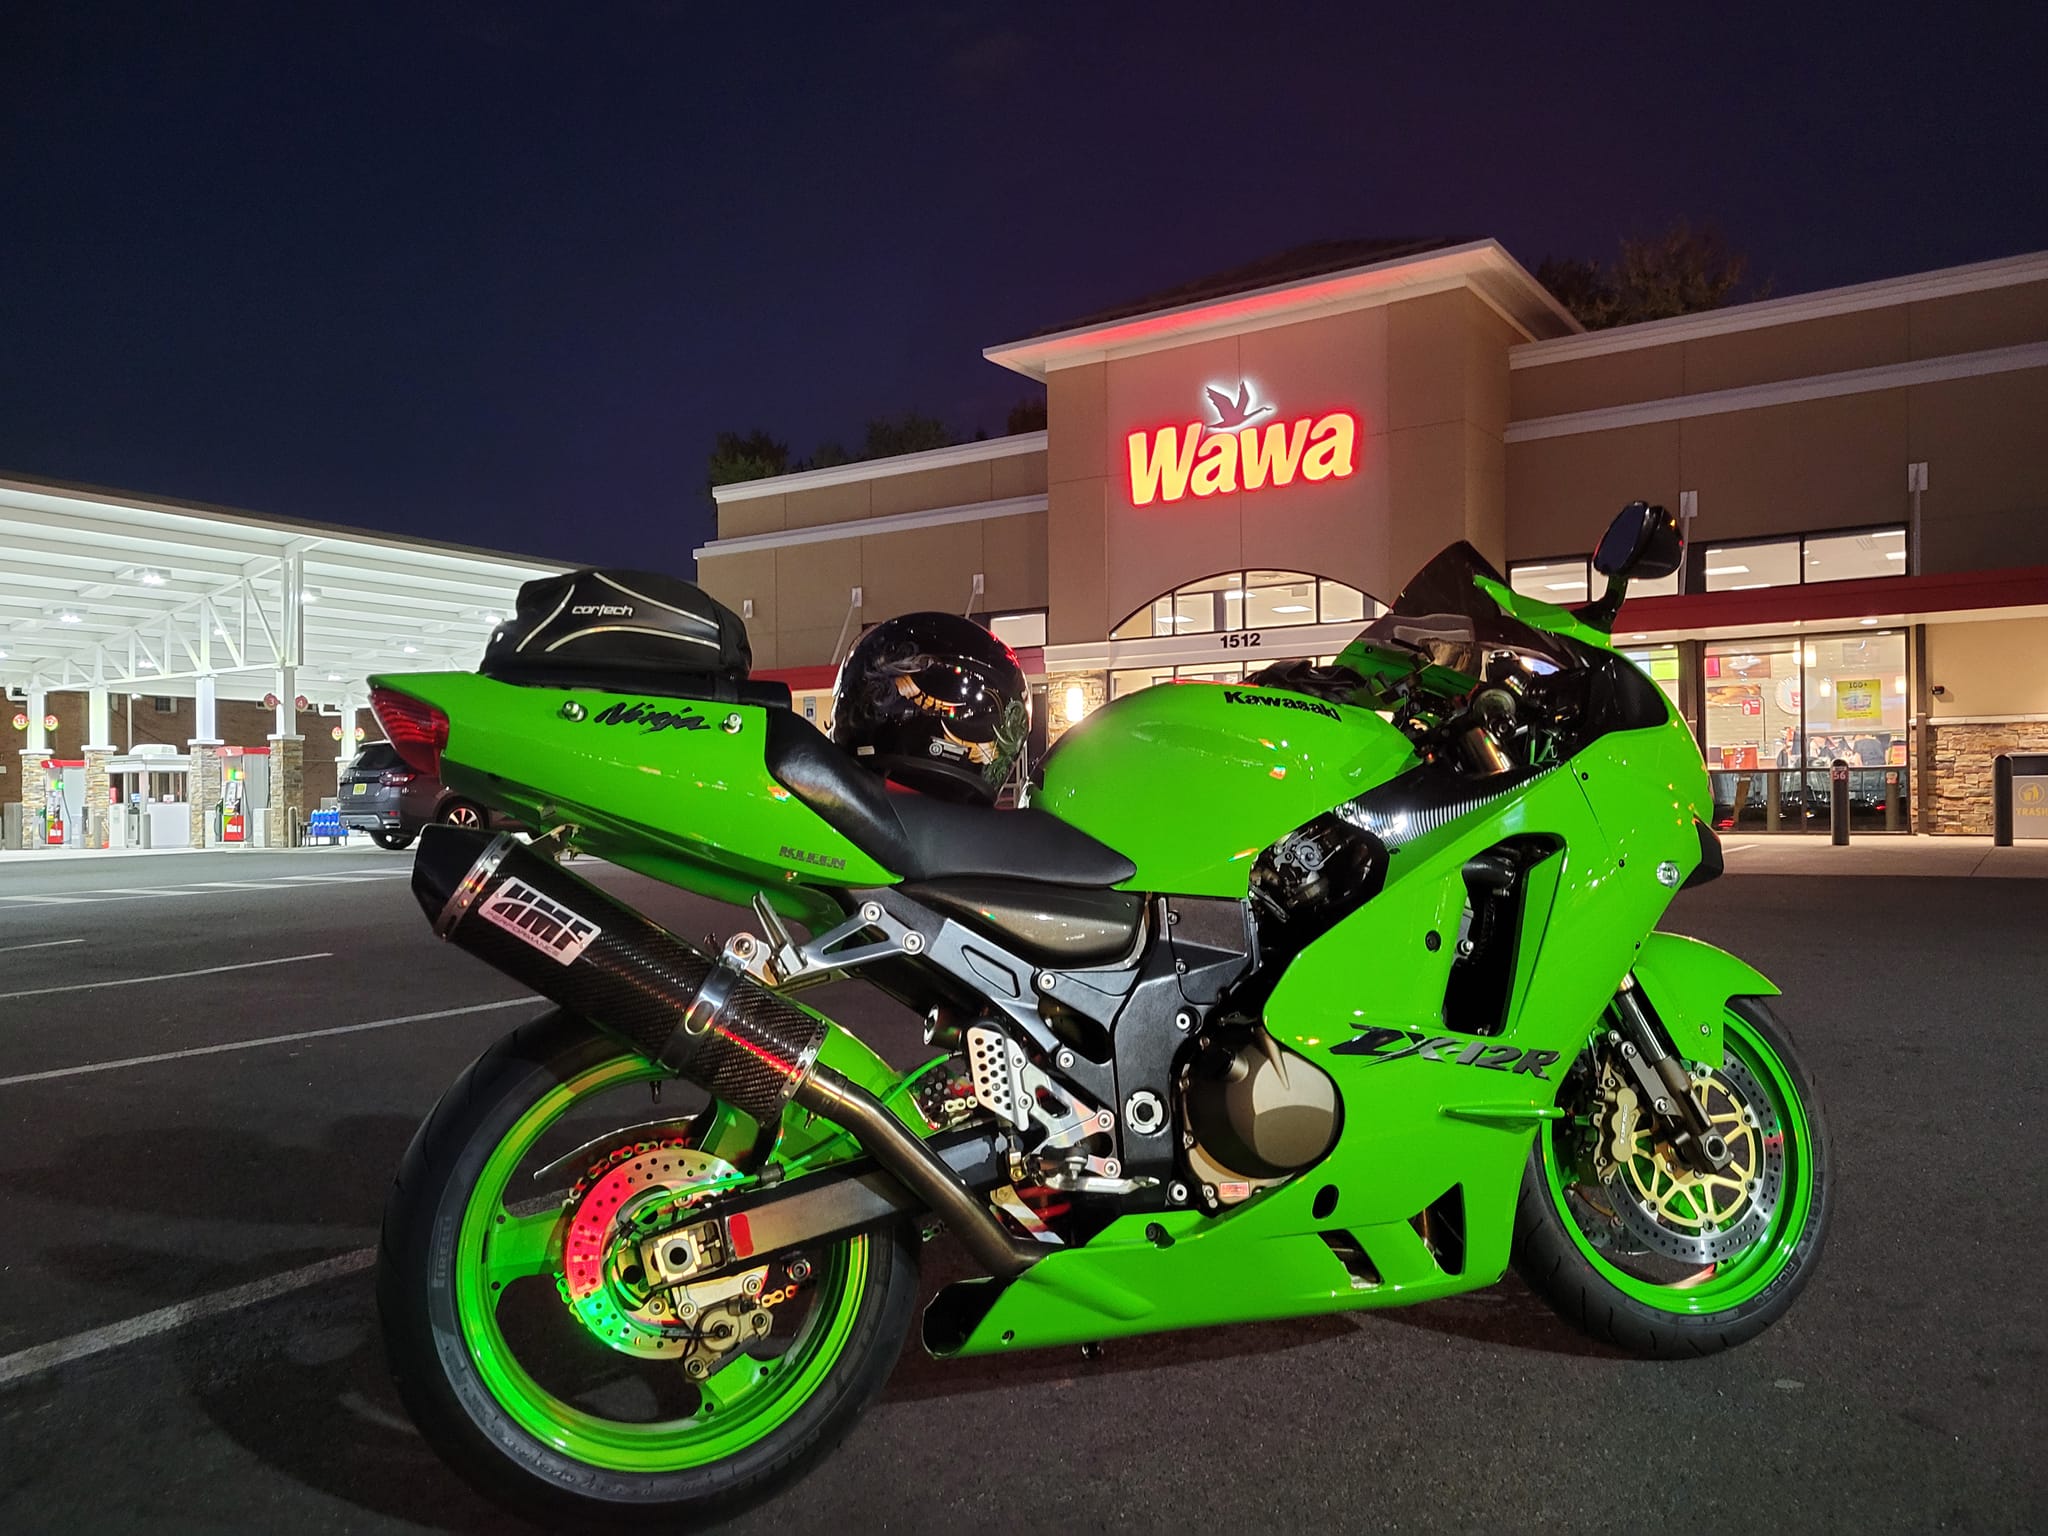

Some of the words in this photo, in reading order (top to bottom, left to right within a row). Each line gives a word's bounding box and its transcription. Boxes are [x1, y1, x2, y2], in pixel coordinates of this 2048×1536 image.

[1128, 412, 1355, 506] Wawa
[571, 603, 634, 618] cortech
[1220, 632, 1261, 649] 1512
[593, 702, 711, 736] Ninja
[1223, 691, 1342, 722] Kawasaki
[1833, 771, 1847, 780] 56
[491, 883, 593, 951] HMF
[1328, 1023, 1561, 1081] ZX-12R
[1754, 1261, 1798, 1304] ROSSO
